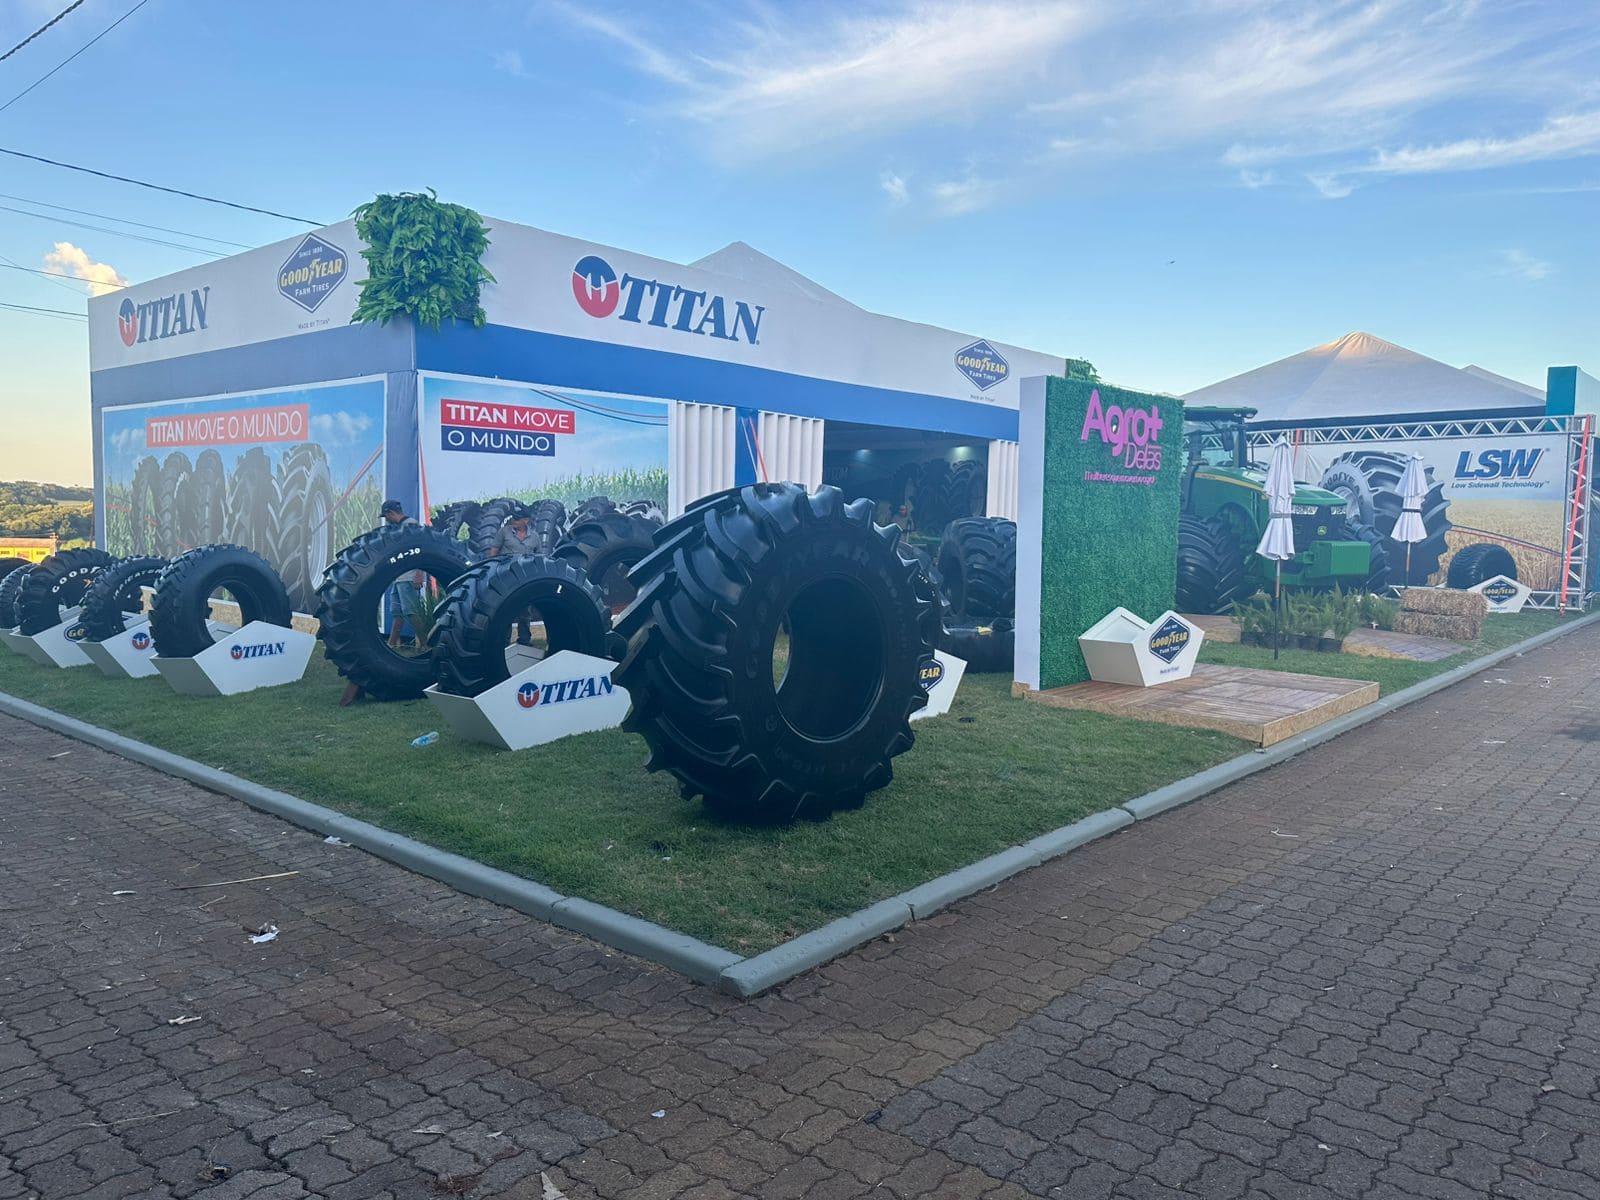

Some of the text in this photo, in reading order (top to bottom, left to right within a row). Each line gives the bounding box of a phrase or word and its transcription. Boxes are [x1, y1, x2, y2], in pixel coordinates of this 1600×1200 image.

[280, 257, 343, 288] GOODYEAR
[295, 282, 330, 297] FARM TIRES
[136, 286, 210, 343] TITAN
[618, 272, 766, 345] TITAN
[957, 355, 1006, 374] GOODYEAR
[150, 410, 303, 443] TITAN MOVE O MUNDO
[446, 403, 570, 429] TITAN MOVE
[448, 430, 550, 451] O MUNDO
[1454, 448, 1545, 480] LSW
[1451, 481, 1467, 489] Low
[1468, 481, 1500, 489] Sidewall
[243, 641, 285, 659] TITAN
[1151, 631, 1188, 648] GOODYEAR
